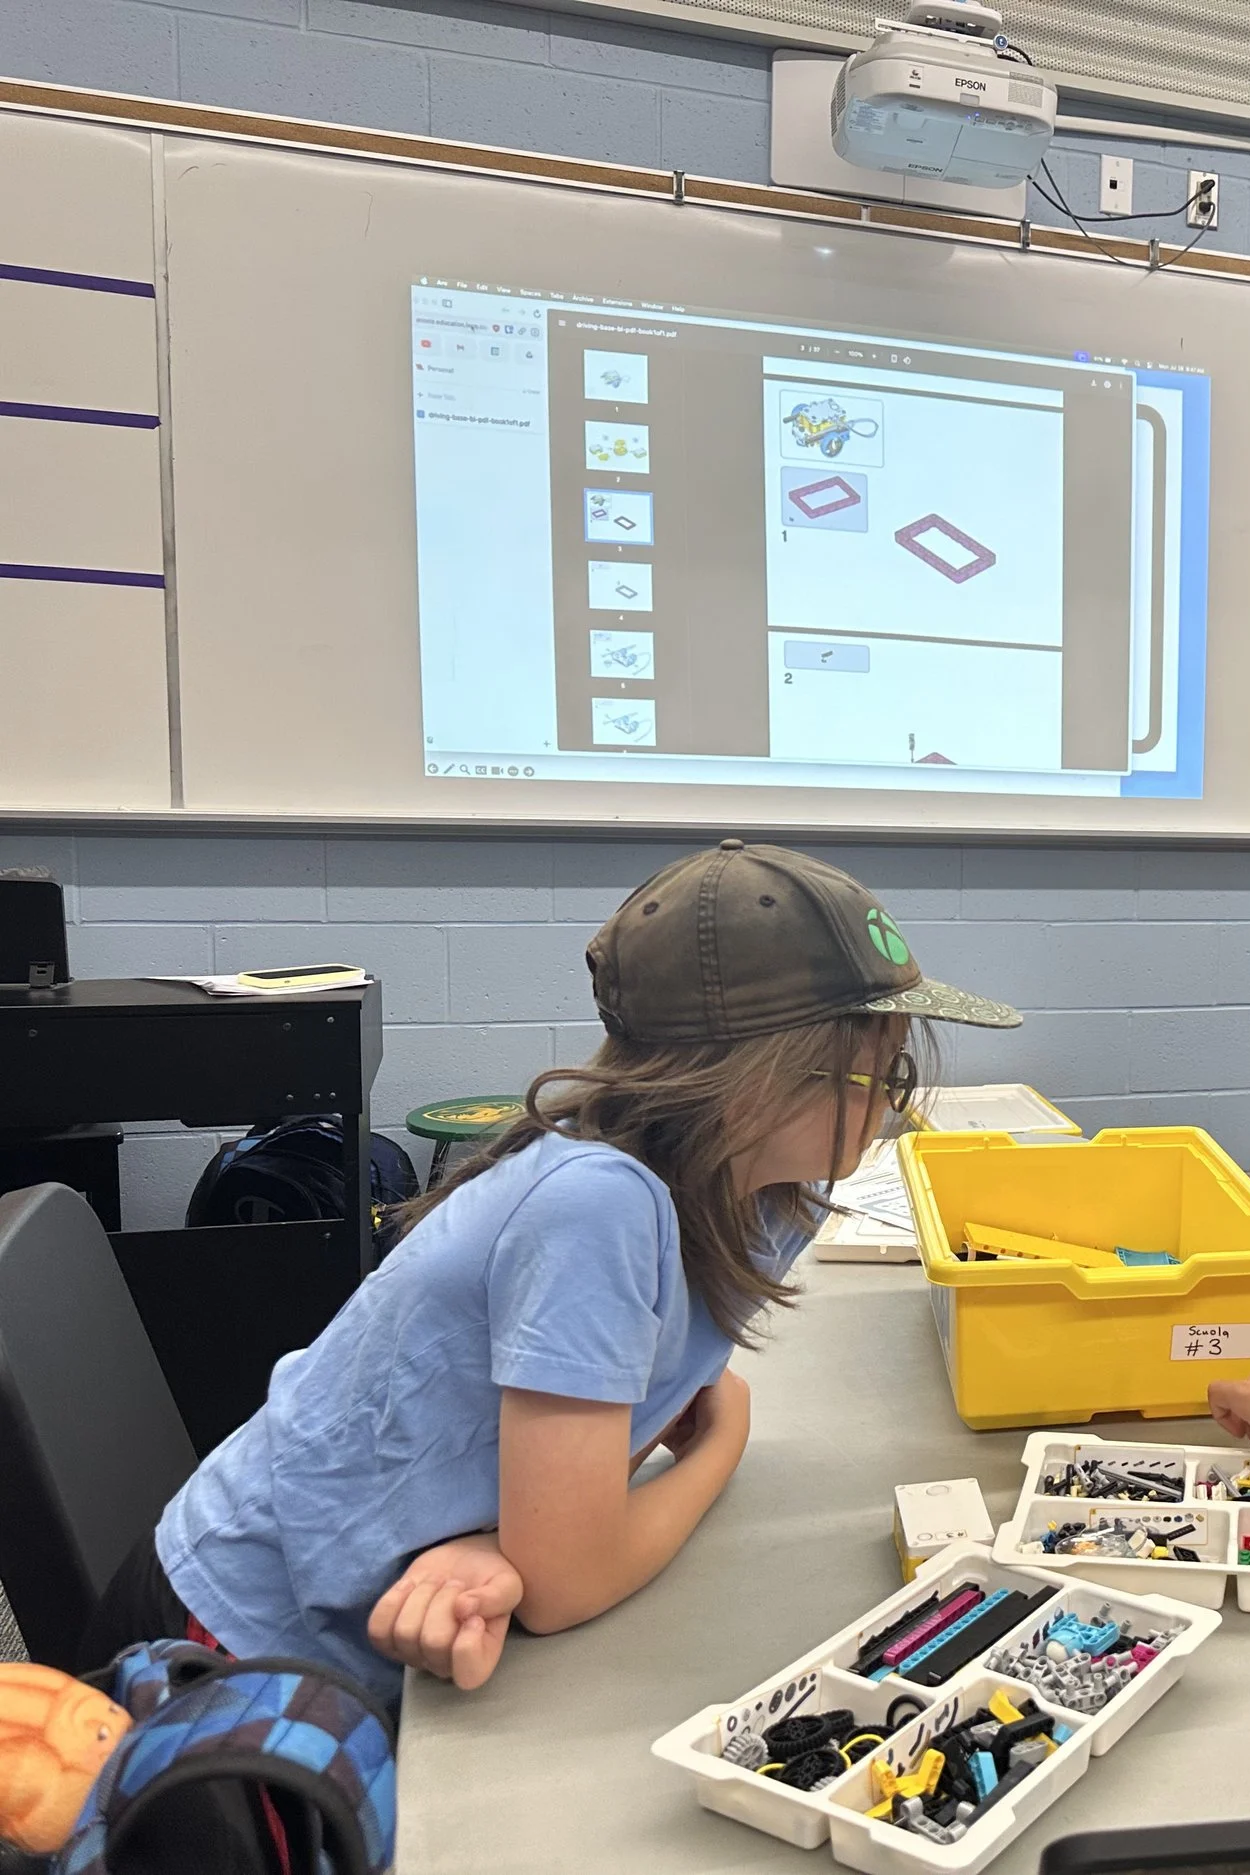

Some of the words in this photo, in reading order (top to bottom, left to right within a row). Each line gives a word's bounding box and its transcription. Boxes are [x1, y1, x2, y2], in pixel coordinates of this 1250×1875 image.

[955, 78, 987, 92] EPSON
[907, 163, 943, 173] EPSON
[496, 286, 511, 294] View
[519, 289, 542, 298] Spaces
[572, 294, 594, 303] Archive
[602, 297, 633, 307] Extensions
[641, 302, 664, 311] Window
[671, 305, 686, 313] Help
[781, 530, 787, 543] 1
[784, 672, 793, 684] 2
[1188, 1325, 1230, 1338] Scuola
[1184, 1338, 1222, 1357] #3
